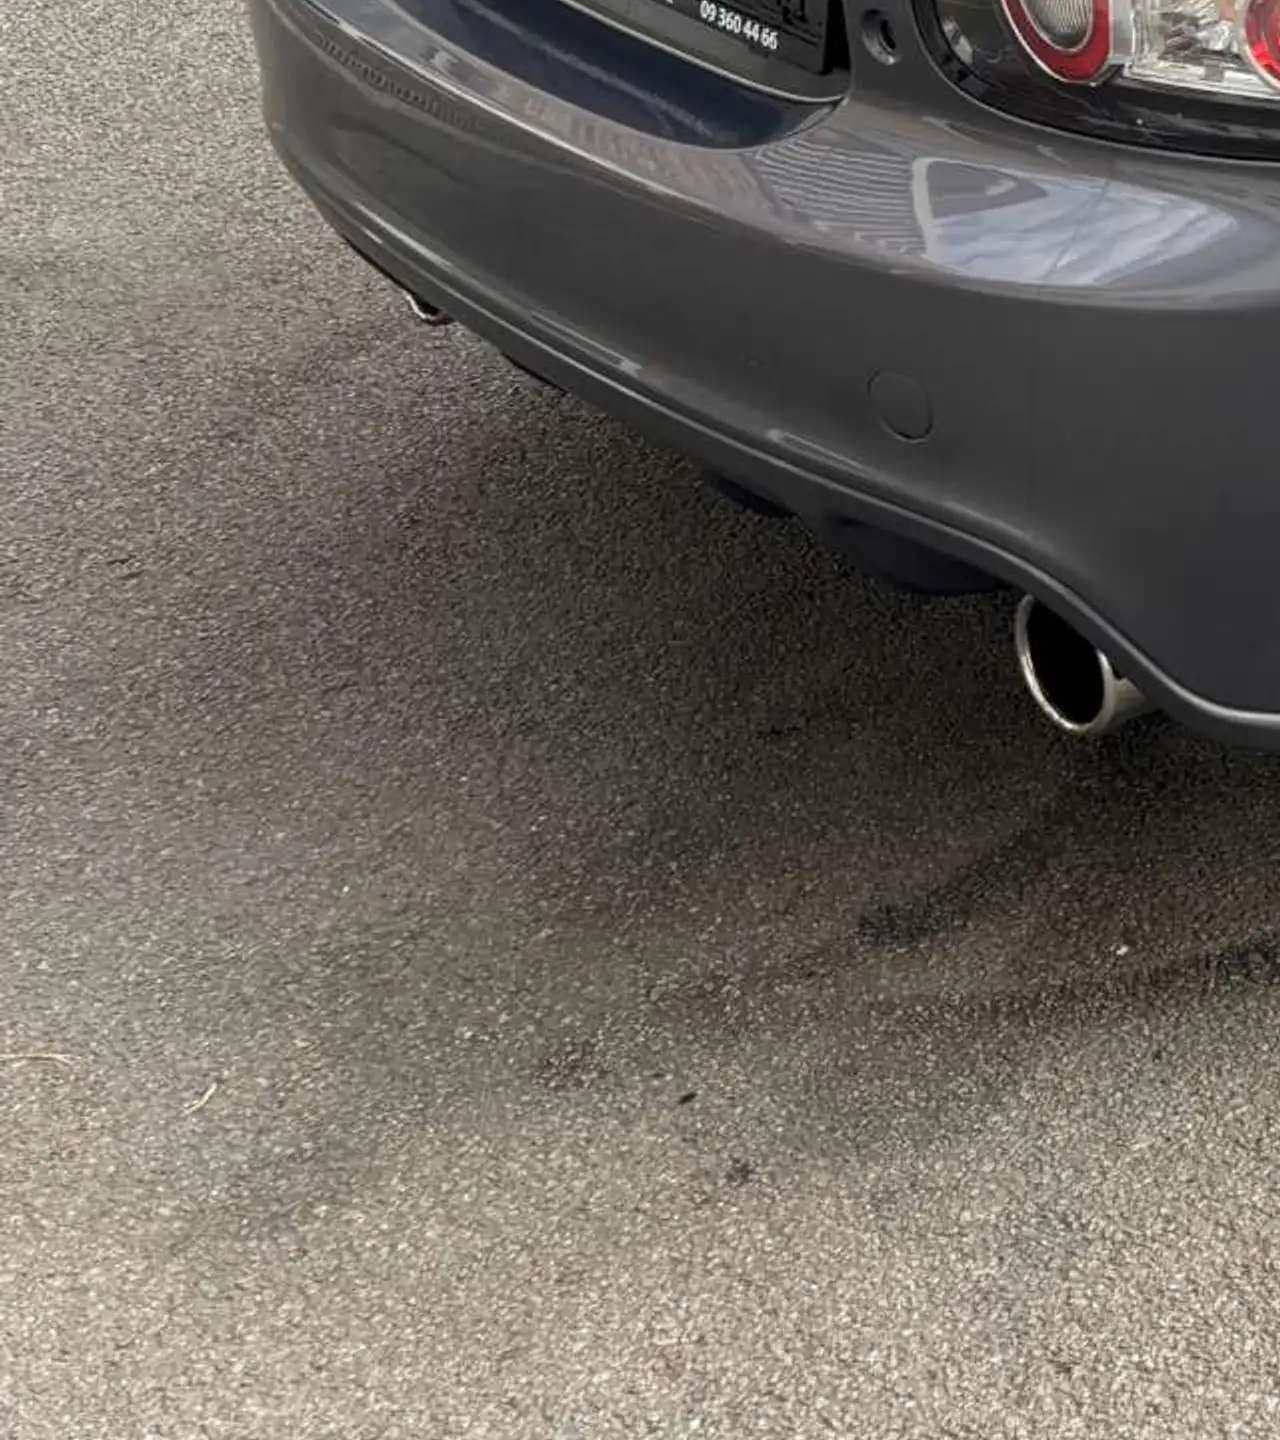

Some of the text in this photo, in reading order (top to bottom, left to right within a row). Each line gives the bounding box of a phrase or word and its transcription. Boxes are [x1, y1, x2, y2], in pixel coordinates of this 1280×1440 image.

[699, 0, 717, 22] 09
[718, 7, 742, 34] 360
[742, 18, 760, 43] 44
[761, 27, 779, 51] 66
